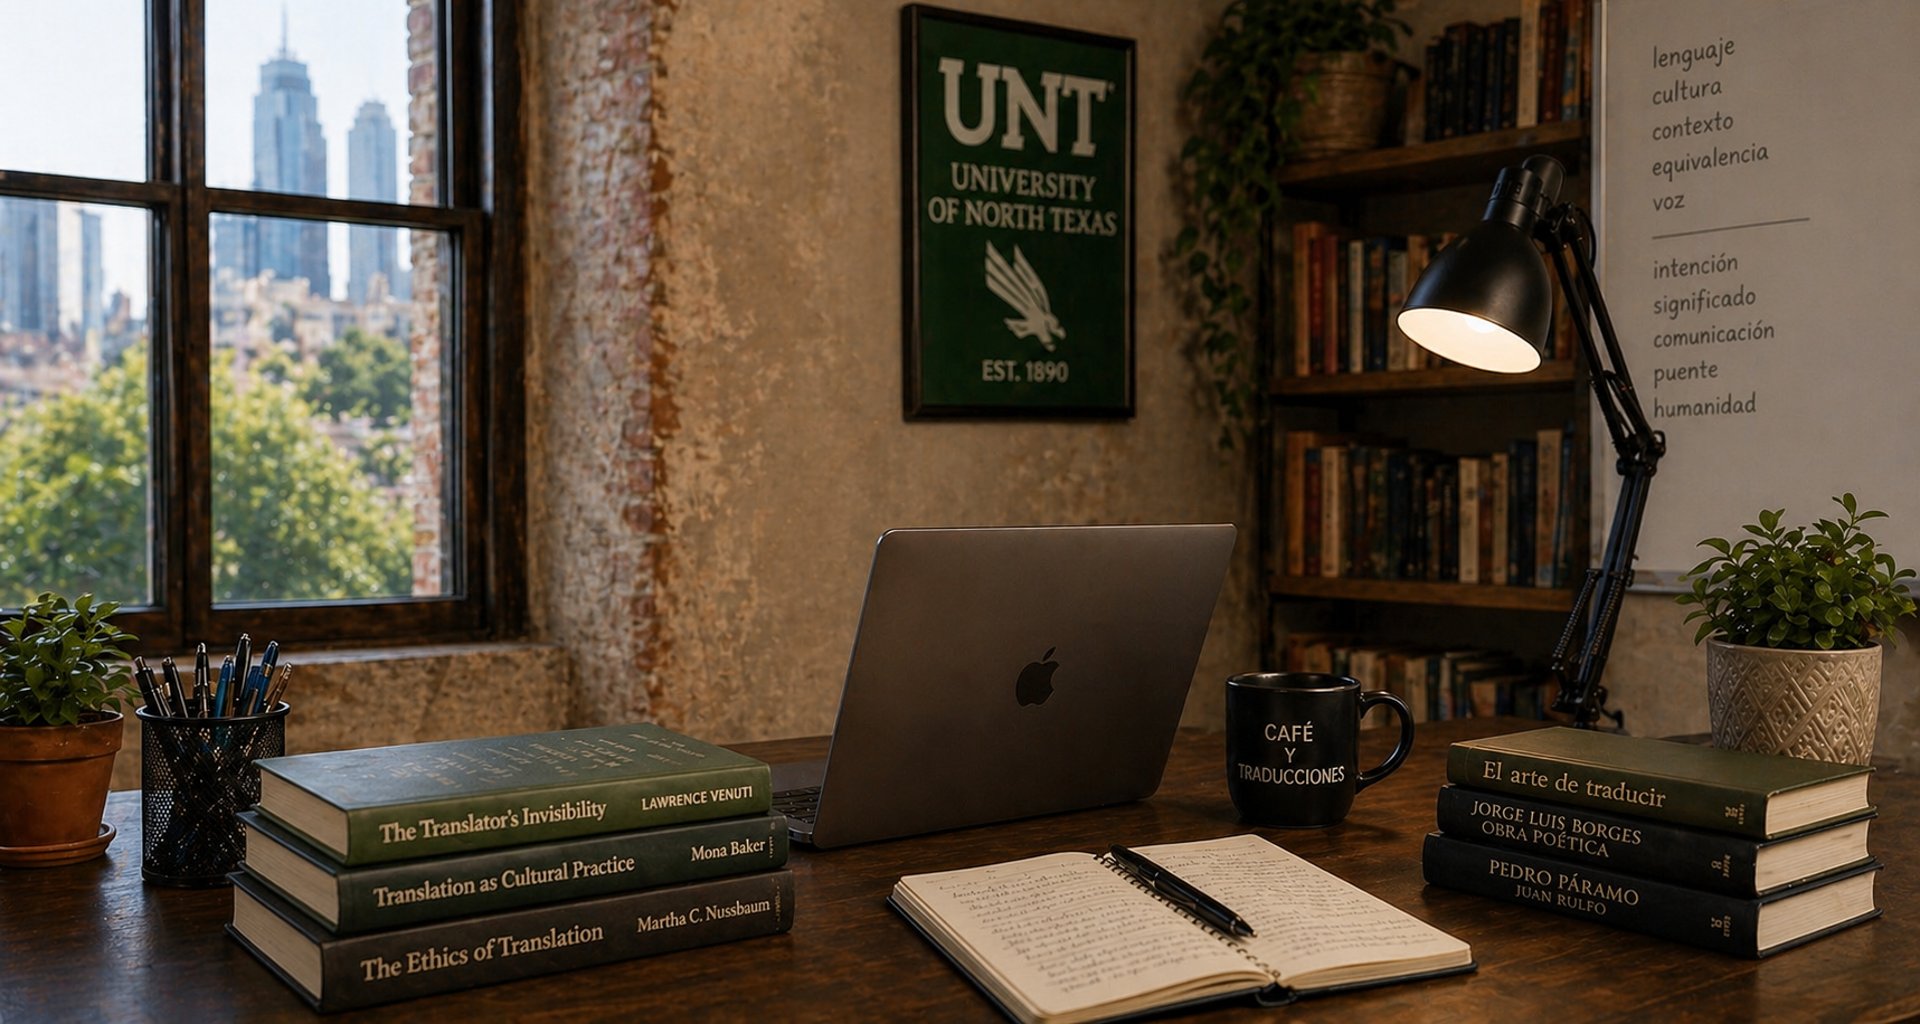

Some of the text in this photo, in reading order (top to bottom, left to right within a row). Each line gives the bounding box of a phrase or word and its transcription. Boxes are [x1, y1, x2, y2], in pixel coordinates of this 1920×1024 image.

[1653, 37, 1735, 72] lenguaje
[938, 57, 1108, 157] UNT
[1652, 80, 1722, 105] cultura
[1652, 111, 1734, 140] contexto
[1652, 143, 1769, 182] equivalencia
[950, 162, 1096, 202] UNIVERSITY
[928, 197, 1118, 237] OF NORTH TEXAS
[1652, 194, 1685, 211] voz
[1653, 252, 1738, 279] intención
[1653, 284, 1756, 320] significado
[1653, 320, 1774, 348] comunicación
[982, 359, 1068, 384] EST. 1890
[1654, 360, 1719, 389] puente
[1654, 391, 1756, 418] humanidad
[1264, 720, 1314, 742] CAFÉ
[1284, 747, 1296, 763] Y
[1238, 763, 1345, 785] TRADUCCIONES
[1482, 760, 1667, 808] El arte de traducir
[642, 785, 753, 811] LAWRENCE VENUTI
[379, 800, 607, 844] The Translator's Invisibility
[1470, 800, 1642, 845] JORGE LUIS BORGES
[691, 845, 727, 862] Mona
[731, 837, 766, 856] Baker
[1481, 821, 1609, 858] OBRA POÉTICA
[373, 856, 635, 907] Translation as Cultural Practice
[1489, 859, 1639, 906] PEDRO PÁRAMO
[636, 910, 687, 933] Martha
[689, 907, 704, 924] C.
[706, 900, 771, 922] Nussbaum
[1515, 885, 1607, 916] JUAN RULFO
[360, 923, 604, 982] The Ethics of Translation
